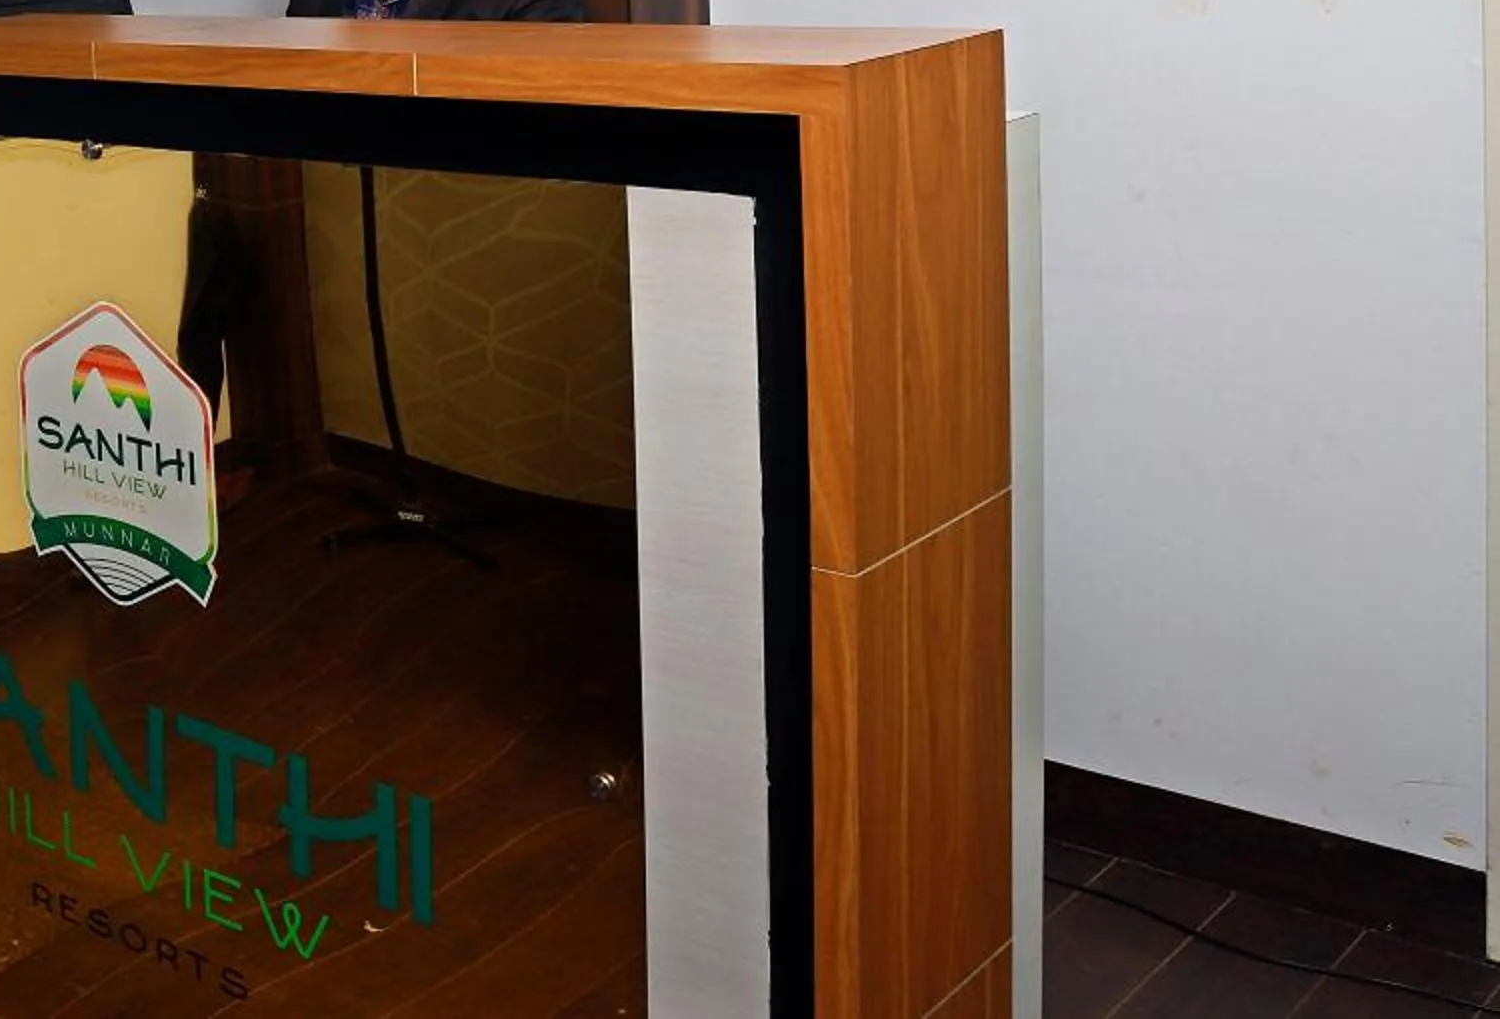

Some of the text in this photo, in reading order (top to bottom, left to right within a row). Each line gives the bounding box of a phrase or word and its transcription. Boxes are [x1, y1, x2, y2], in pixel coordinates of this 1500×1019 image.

[36, 415, 197, 486] SANTHI
[63, 459, 167, 501] HILL VIEW
[64, 522, 172, 565] MUNNAR
[118, 834, 329, 960] VIEW
[31, 881, 249, 1001] RESORTS
